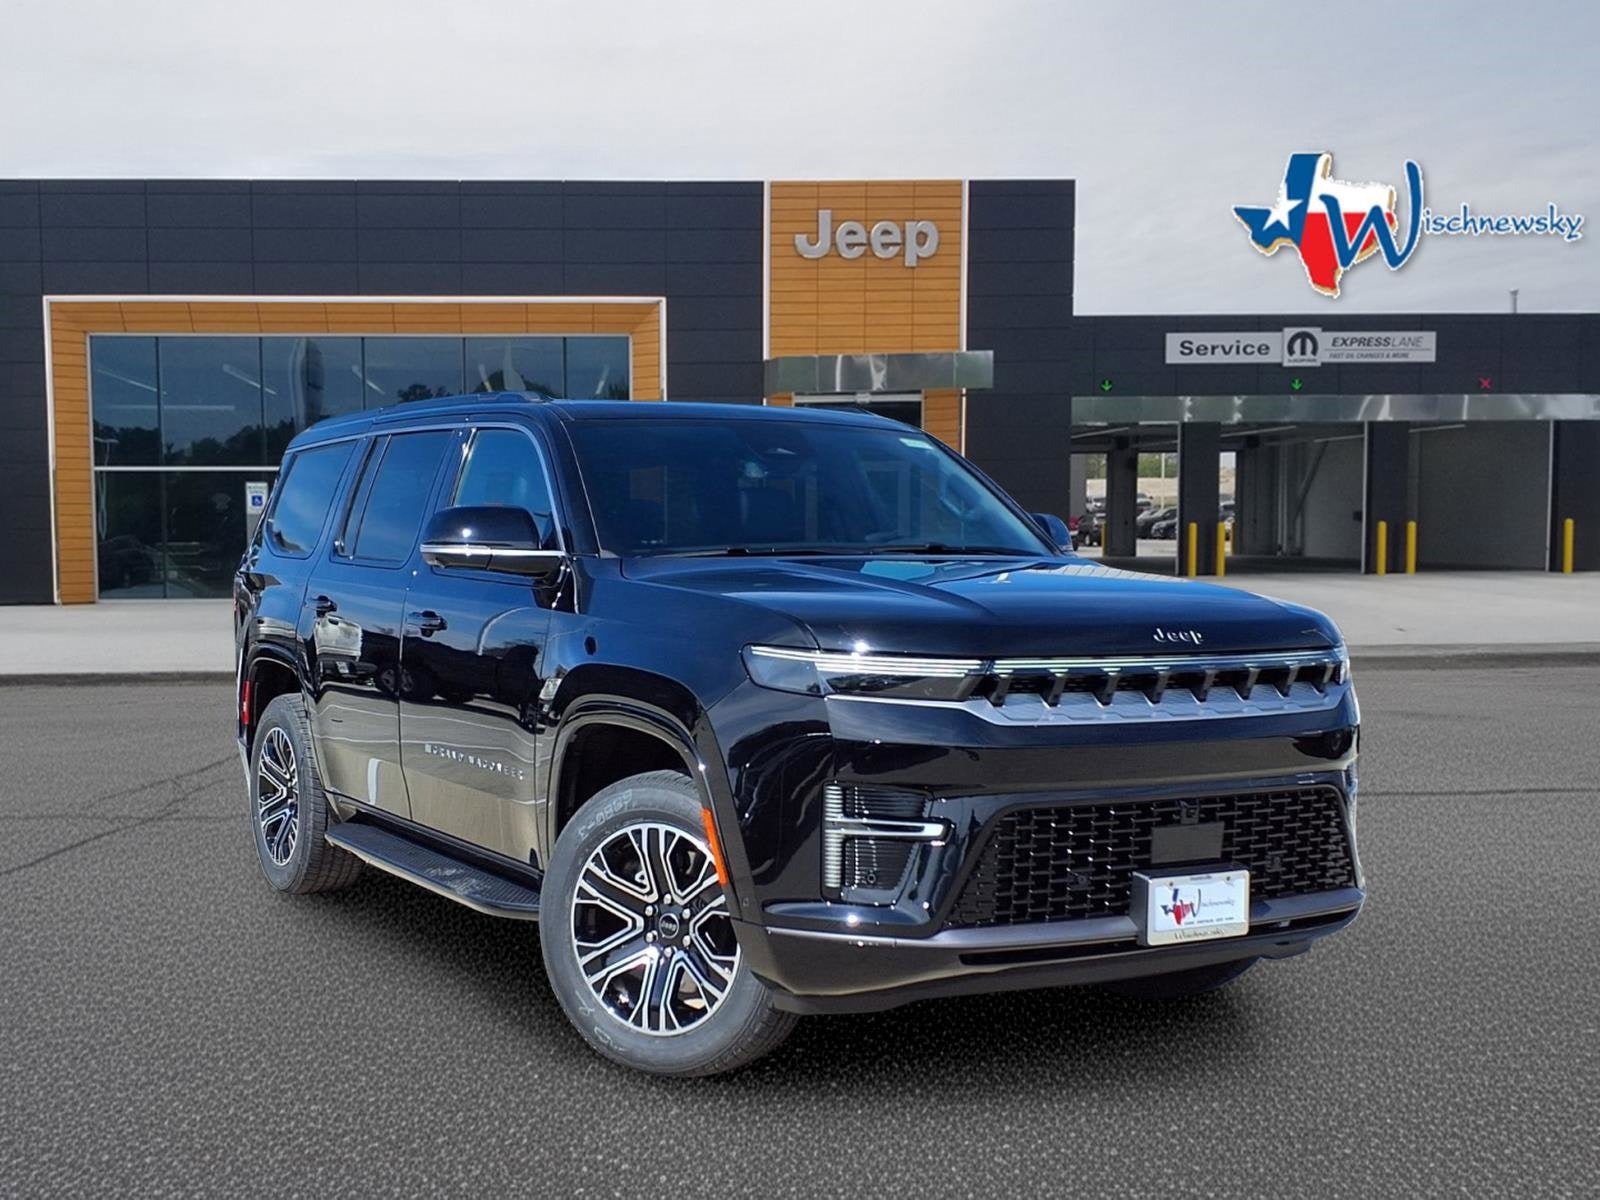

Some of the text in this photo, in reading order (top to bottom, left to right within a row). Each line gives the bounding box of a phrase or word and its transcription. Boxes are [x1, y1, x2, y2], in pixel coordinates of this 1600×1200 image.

[794, 209, 940, 268] Jeep
[1178, 340, 1271, 357] Service
[1153, 628, 1204, 645] Jeep
